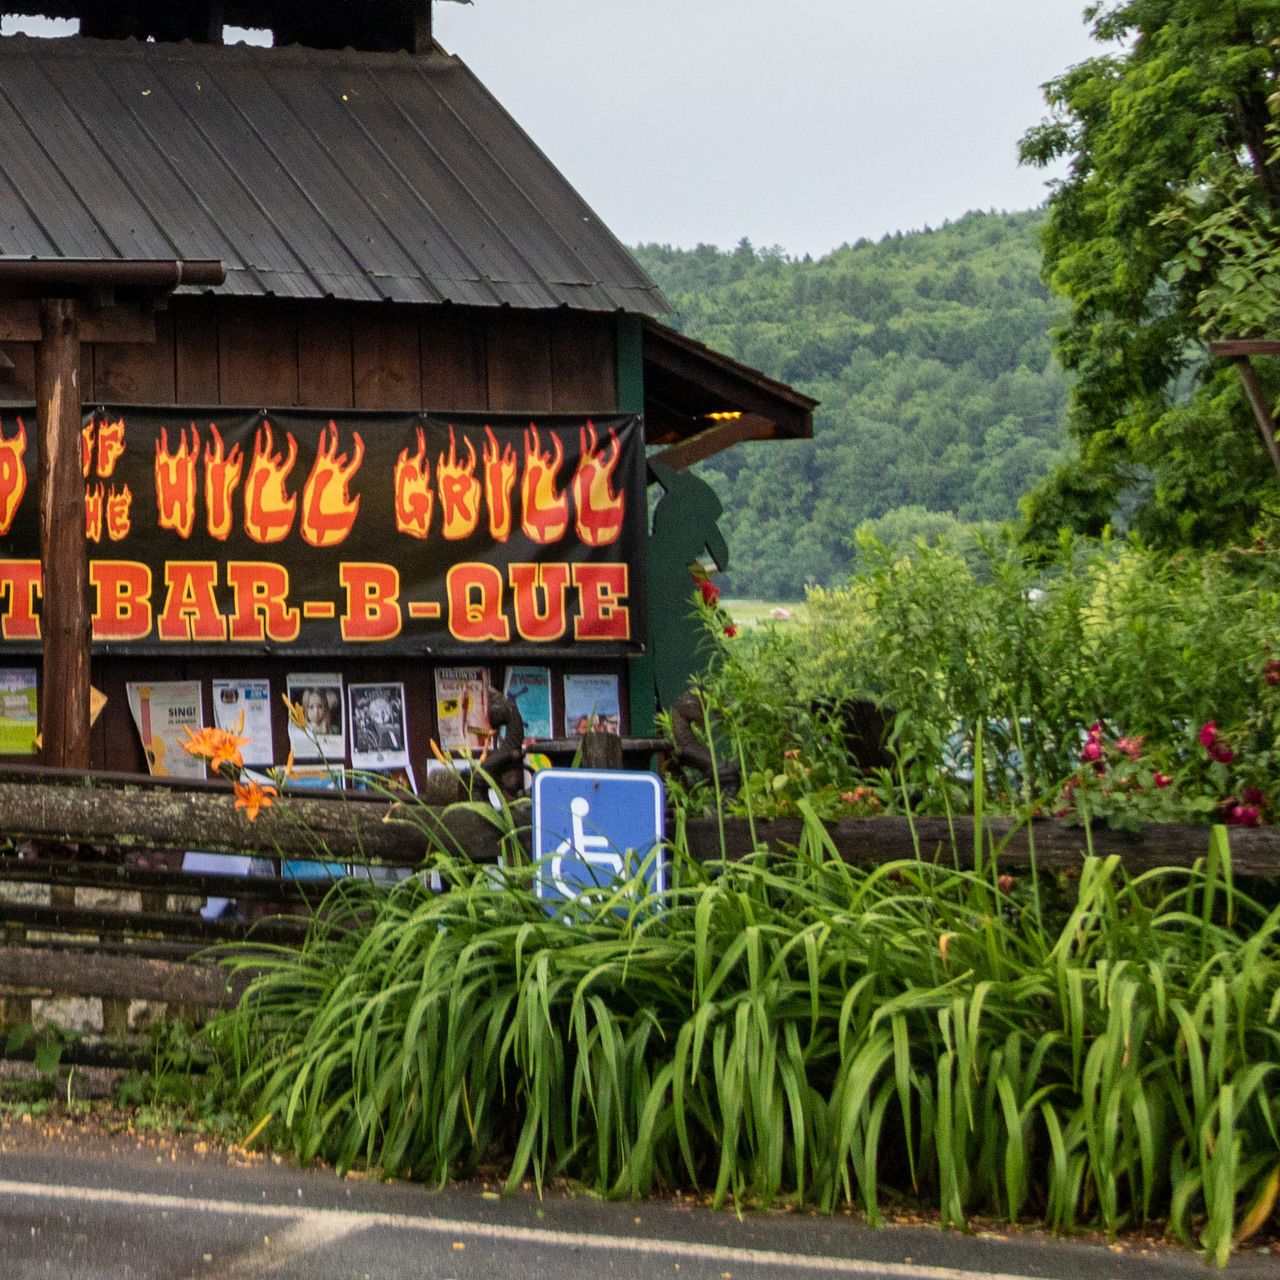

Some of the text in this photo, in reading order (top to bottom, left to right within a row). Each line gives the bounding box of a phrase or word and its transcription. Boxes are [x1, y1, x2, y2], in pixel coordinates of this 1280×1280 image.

[85, 482, 131, 542] HE
[155, 419, 365, 547] HILL
[394, 419, 626, 547] GRILL
[90, 560, 631, 642] BAR-B-QUE
[168, 707, 196, 718] SING!
